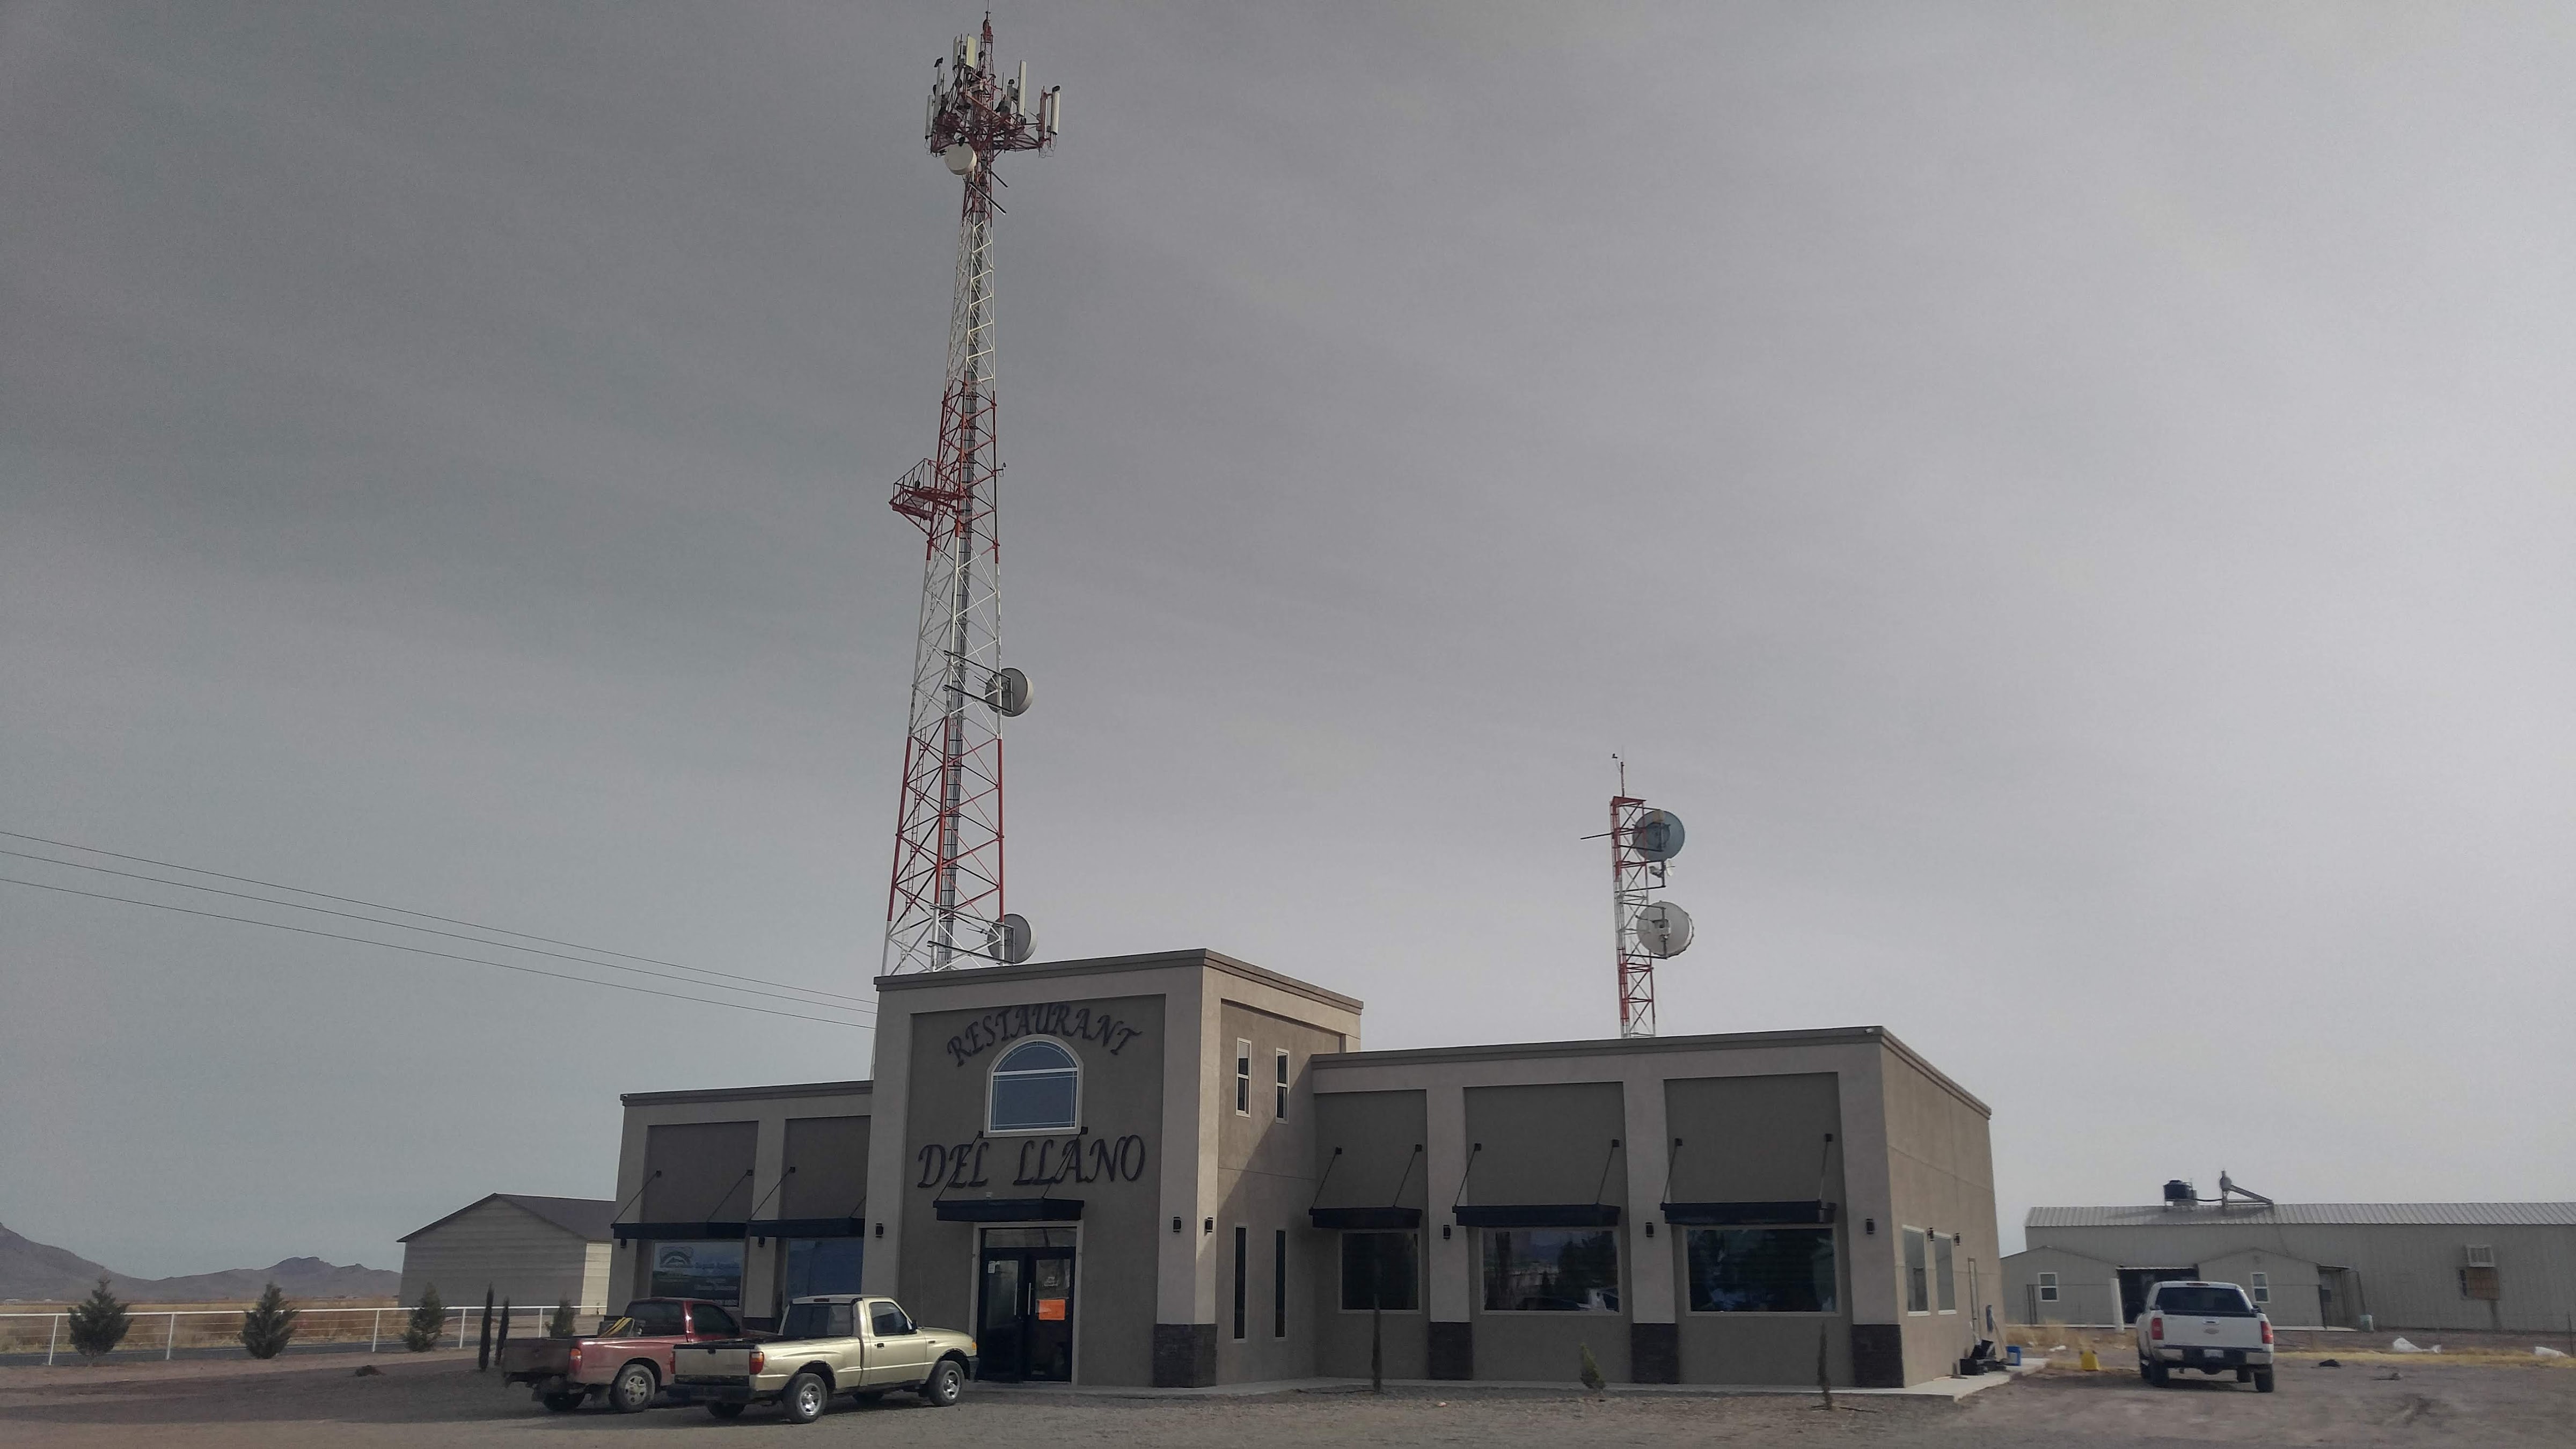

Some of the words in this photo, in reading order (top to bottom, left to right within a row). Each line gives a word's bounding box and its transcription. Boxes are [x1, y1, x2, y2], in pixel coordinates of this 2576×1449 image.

[947, 1001, 1144, 1067] RESTAURANT
[917, 1141, 989, 1188] DEL
[1013, 1135, 1146, 1185] LLANO
